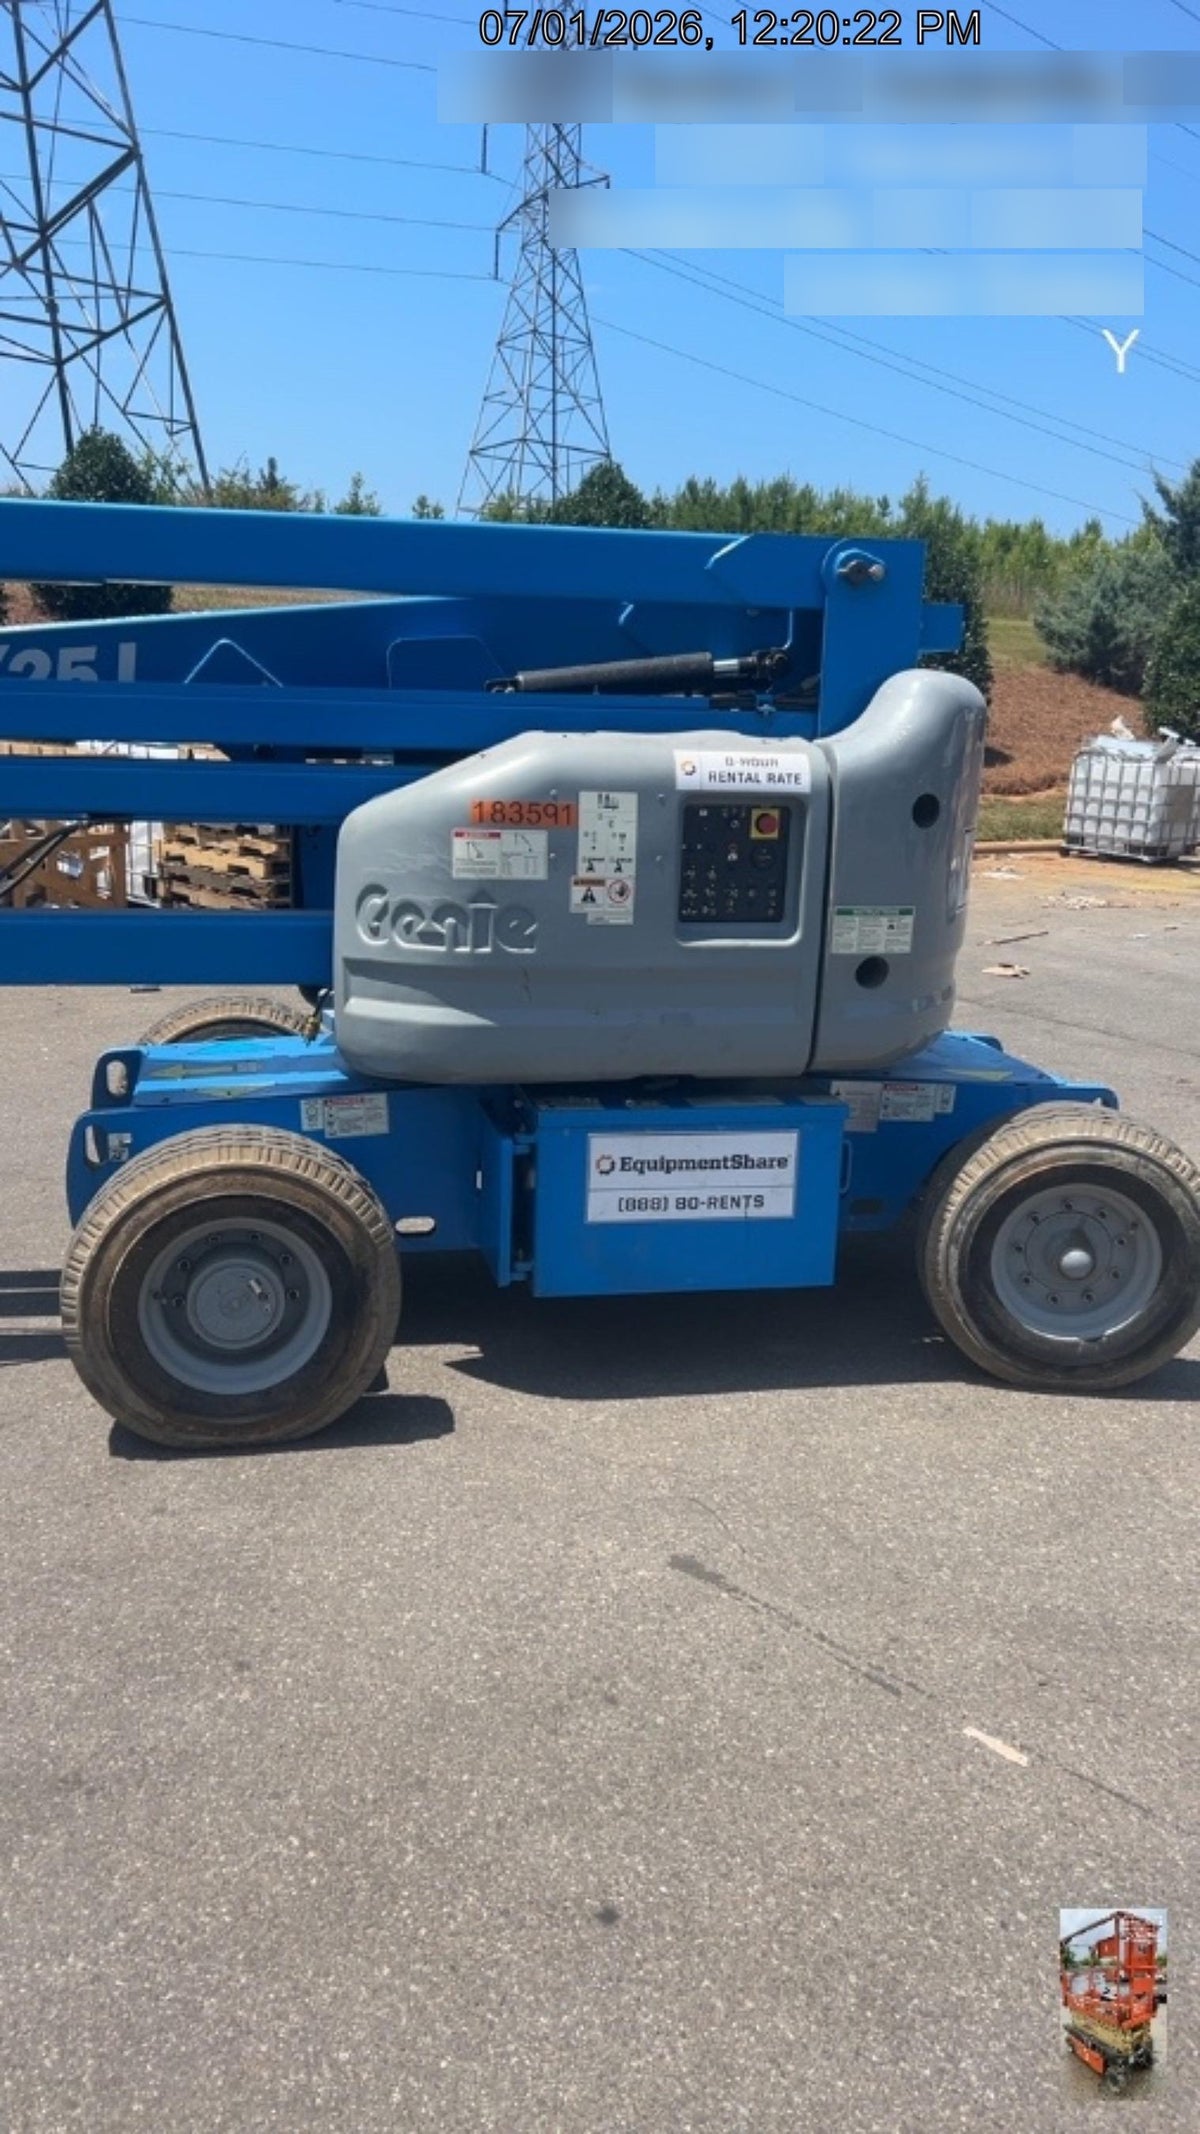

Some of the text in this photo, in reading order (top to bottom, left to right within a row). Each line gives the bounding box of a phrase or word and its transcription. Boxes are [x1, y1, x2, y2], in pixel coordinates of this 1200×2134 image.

[708, 771, 803, 785] RENTAL RATE
[473, 801, 573, 826] 183591
[355, 883, 540, 954] Genie
[619, 1153, 788, 1175] EquipmentShare
[675, 1194, 765, 1211] 80-RENTS
